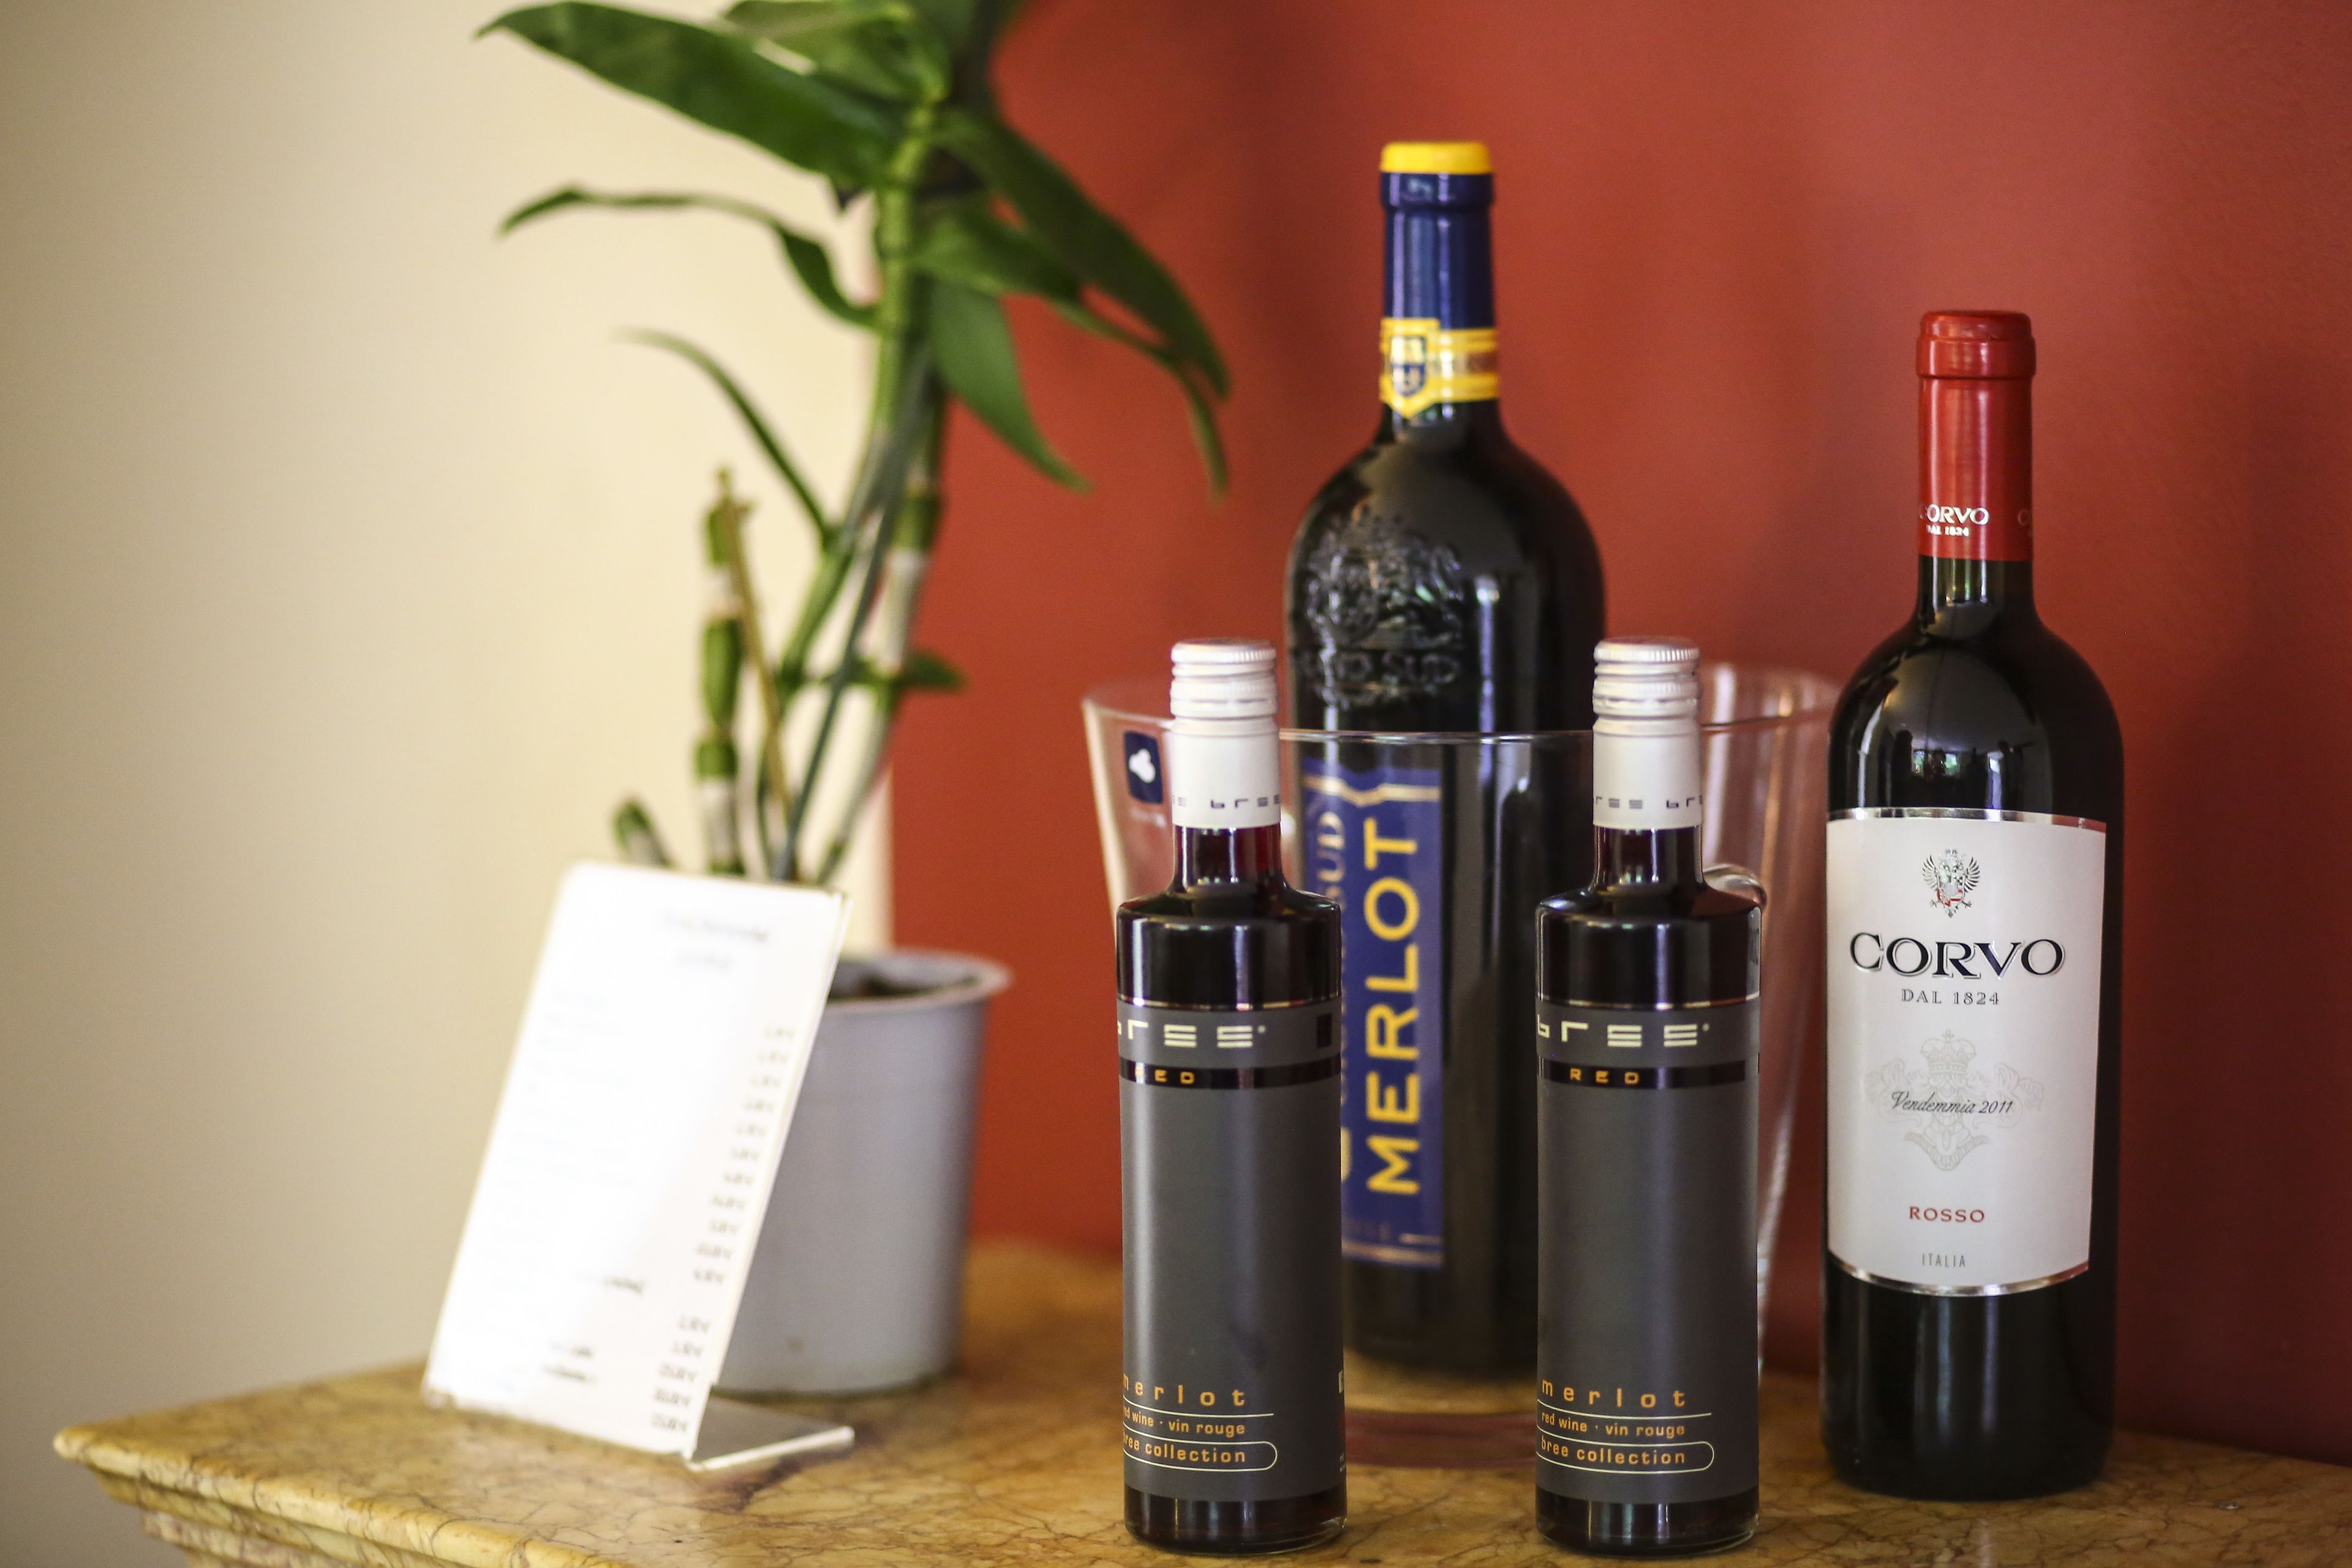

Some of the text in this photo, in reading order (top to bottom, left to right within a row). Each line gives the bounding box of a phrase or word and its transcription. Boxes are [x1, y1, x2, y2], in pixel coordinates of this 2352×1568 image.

[1593, 795, 1643, 810] ree
[1850, 932, 2065, 979] CORVO
[1363, 818, 1420, 1195] MERLOT
[1901, 989, 1999, 1005] DAL 1824
[1570, 1068, 1640, 1085] RED
[1891, 1091, 2013, 1114] Vendemmia 2011
[1909, 1205, 1985, 1223] ROSSO
[1922, 1253, 1966, 1268] ITALIA
[1542, 1379, 1686, 1408] merlot
[1132, 1411, 1154, 1427] wine
[1169, 1419, 1189, 1433] vin
[1196, 1423, 1245, 1438] rouge
[1542, 1411, 1685, 1439] red wine vin rouge
[1145, 1443, 1245, 1463] collection
[1541, 1436, 1686, 1465] bree collection
